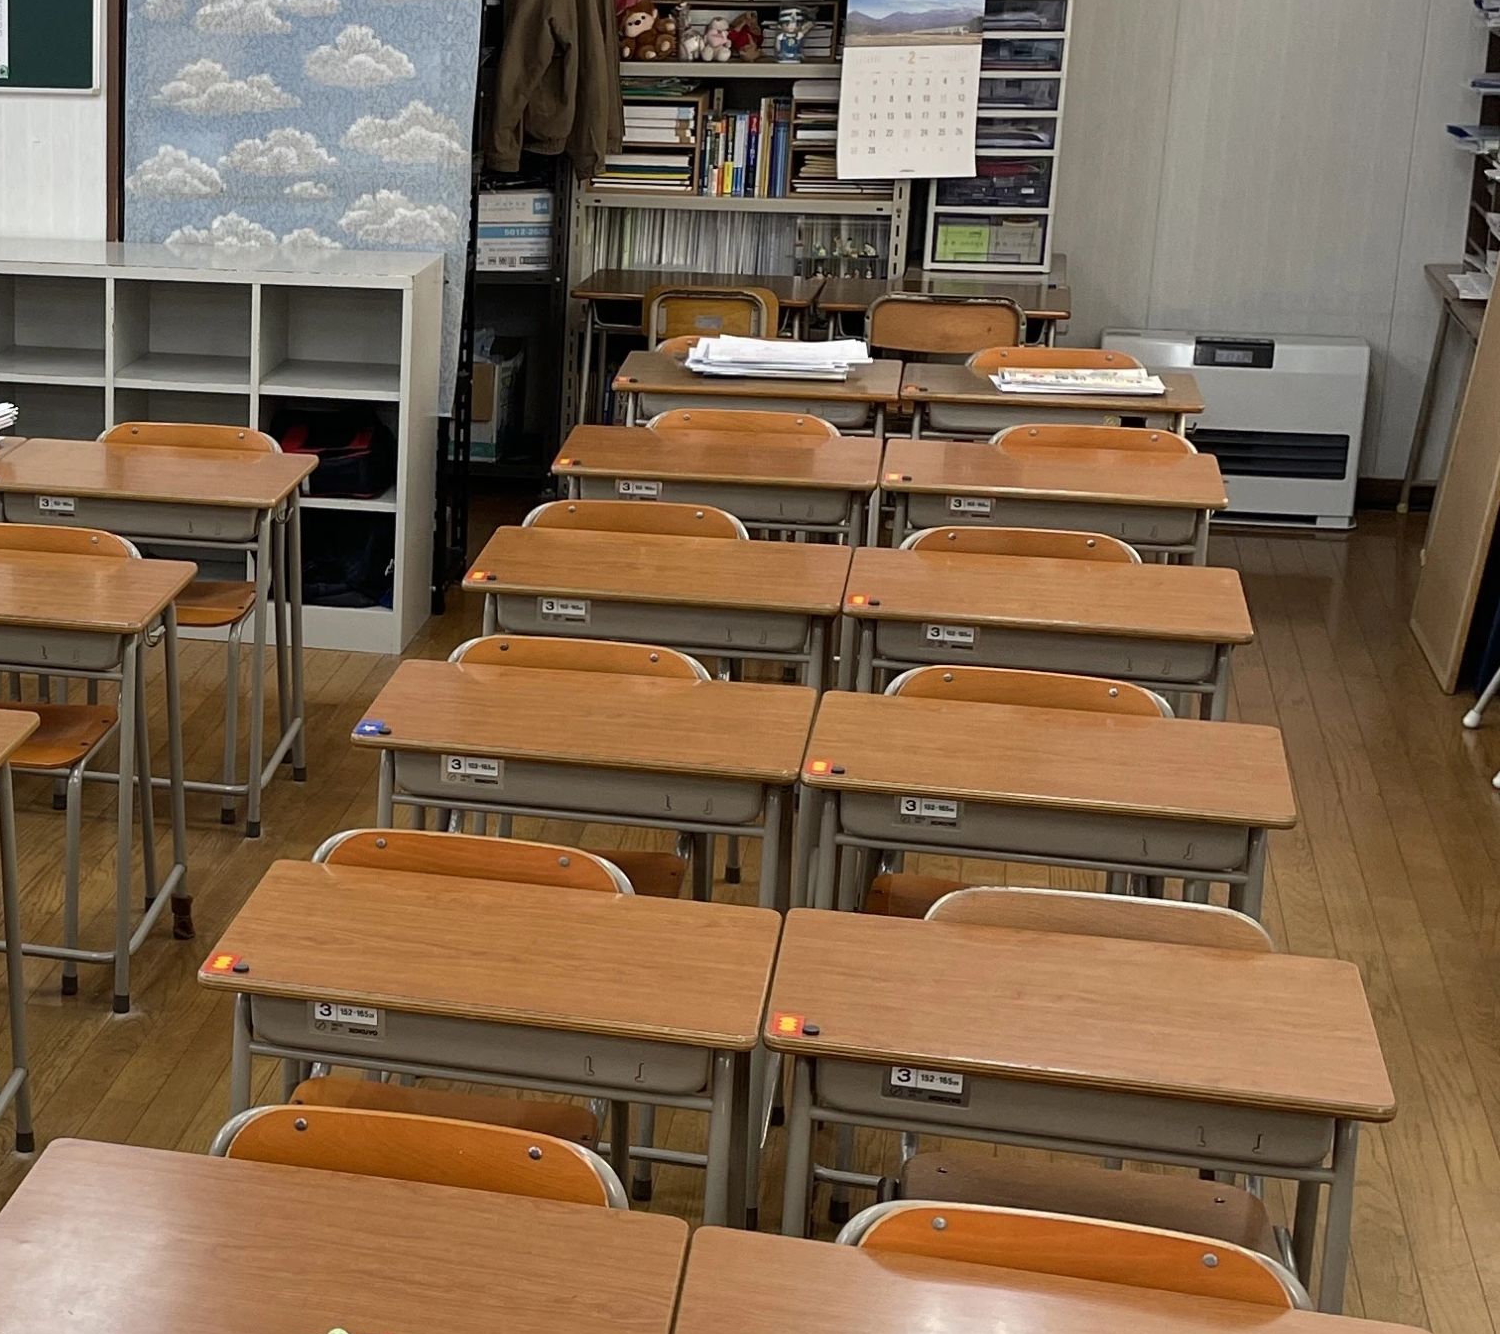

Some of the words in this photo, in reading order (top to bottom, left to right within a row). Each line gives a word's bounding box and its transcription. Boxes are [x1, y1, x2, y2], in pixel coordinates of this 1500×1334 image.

[907, 51, 916, 64] 2
[622, 482, 630, 491] 3
[954, 499, 961, 507] 3
[546, 601, 554, 611] 3
[931, 627, 940, 637] 3
[452, 759, 461, 769] 3
[905, 800, 916, 811] 3
[320, 1003, 332, 1016] 3
[897, 1069, 911, 1082] 3
